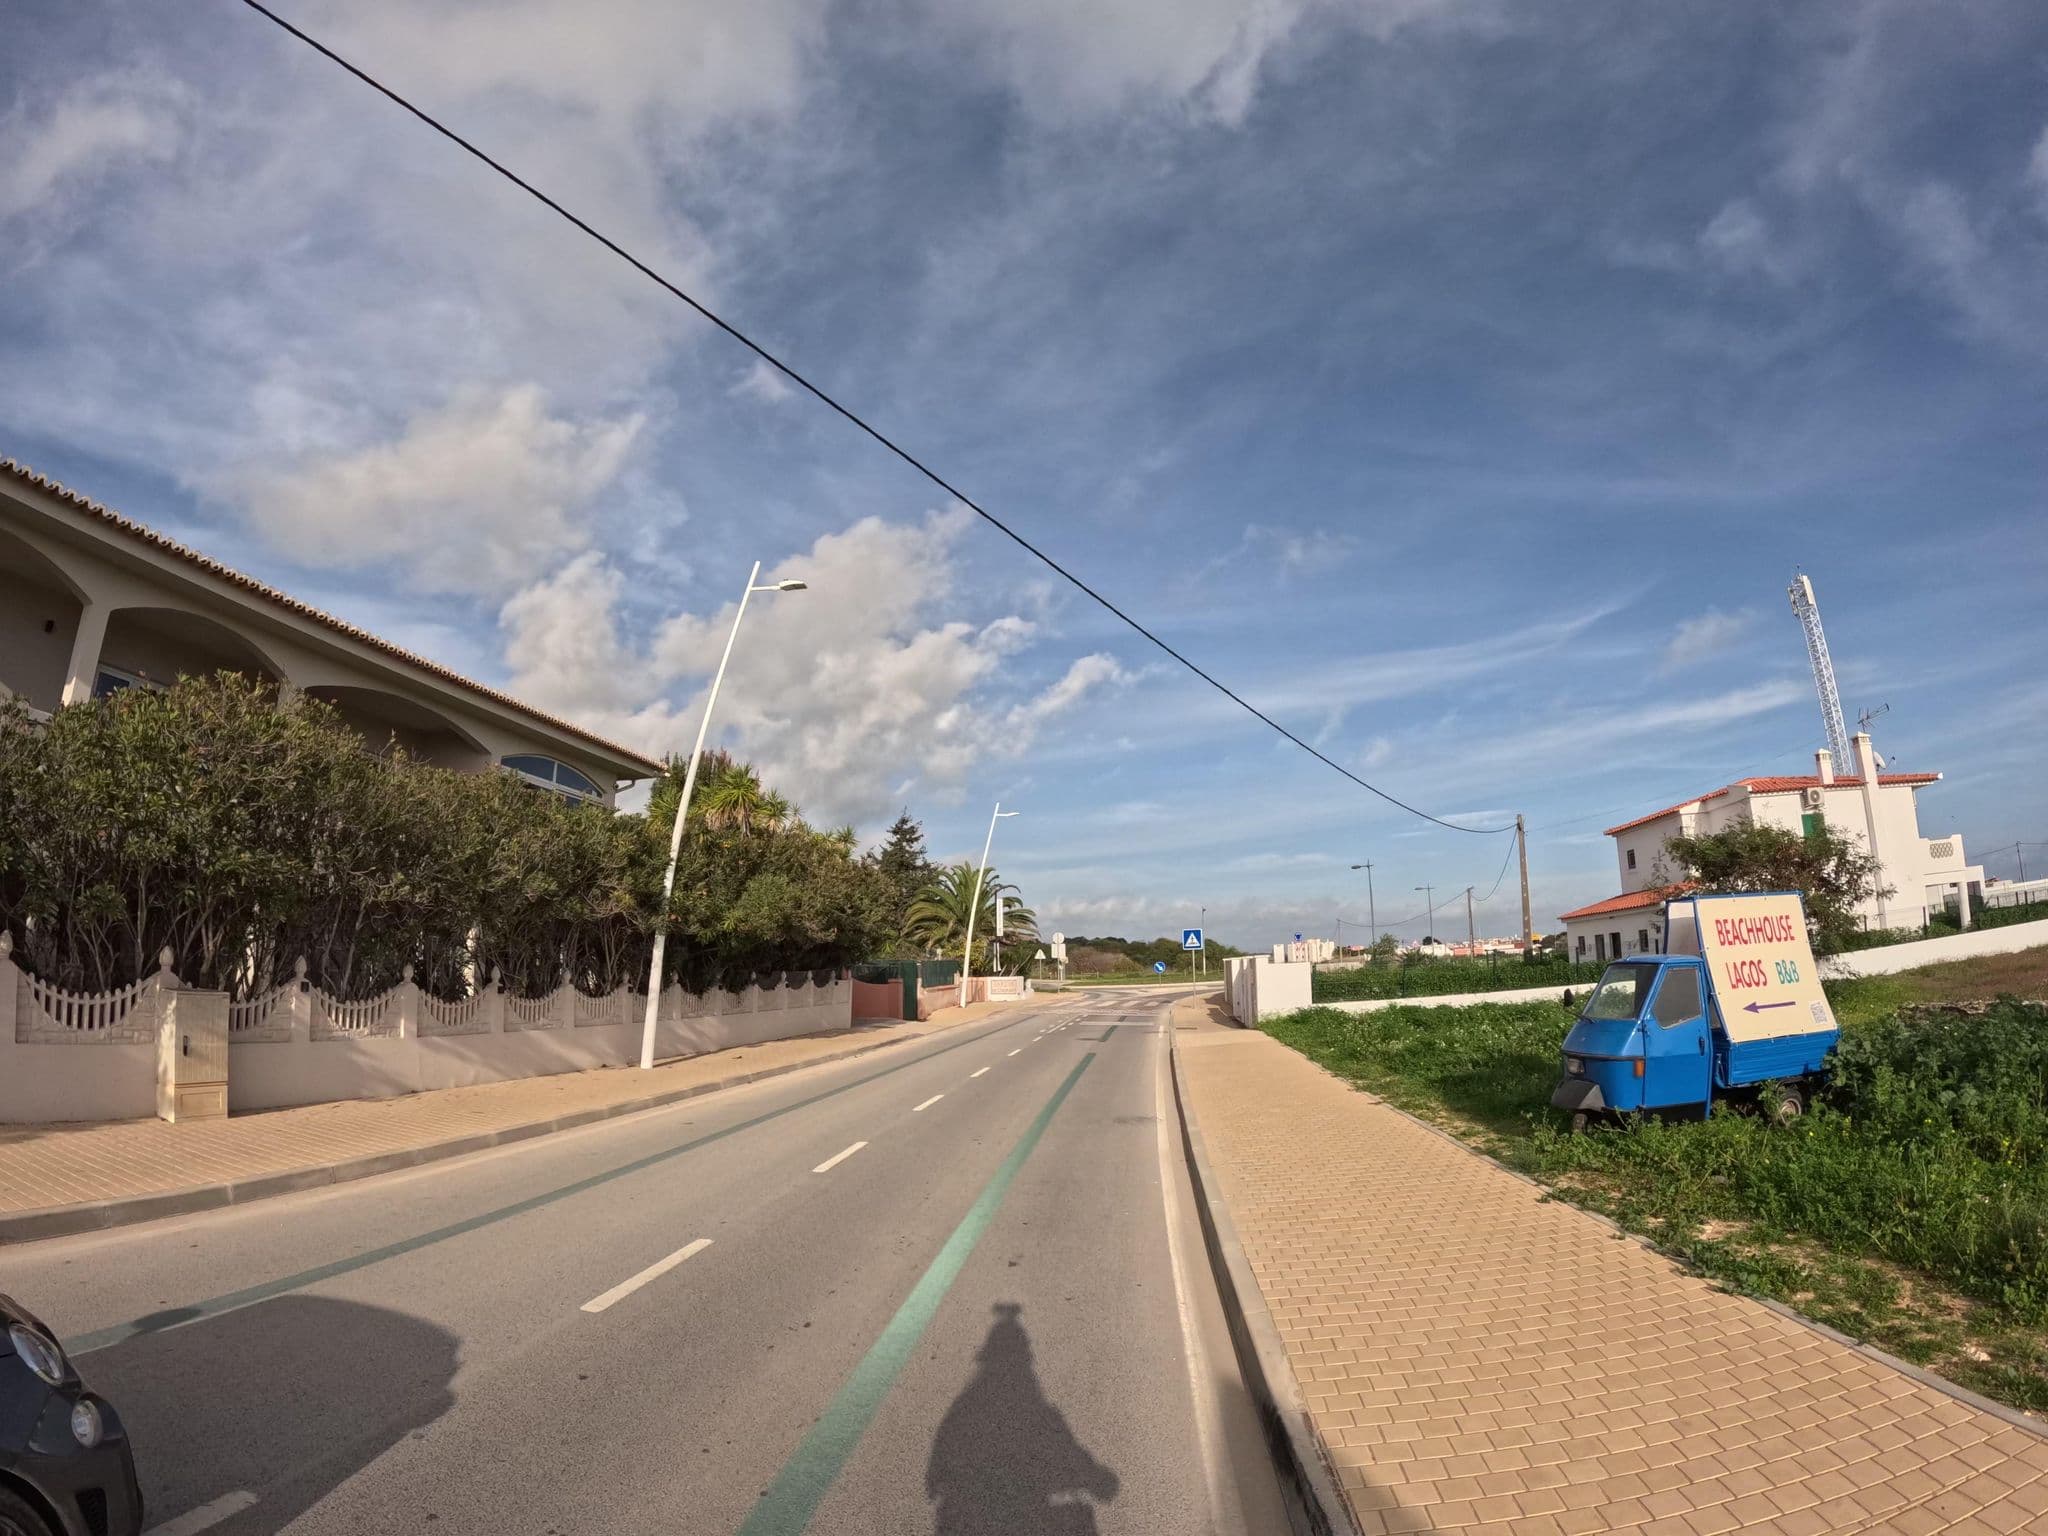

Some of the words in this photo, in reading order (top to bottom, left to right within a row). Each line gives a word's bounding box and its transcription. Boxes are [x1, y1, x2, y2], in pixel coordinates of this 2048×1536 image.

[1715, 914, 1795, 946] BEACHHOUSE
[1725, 959, 1768, 989] LAGOS
[1775, 960, 1800, 985] B&B
